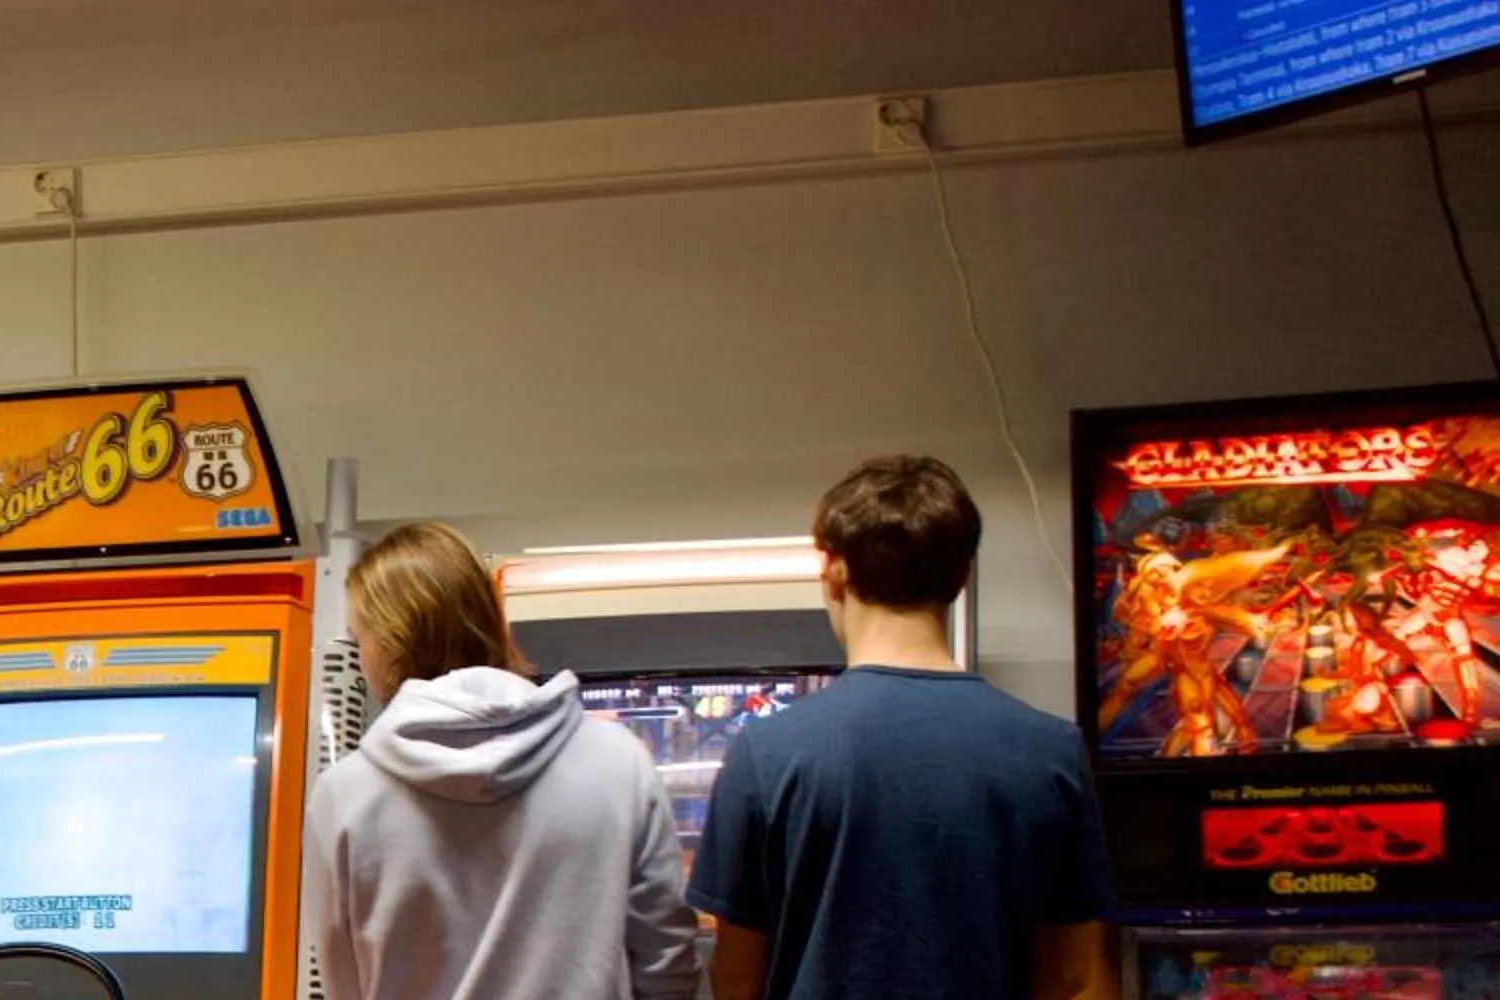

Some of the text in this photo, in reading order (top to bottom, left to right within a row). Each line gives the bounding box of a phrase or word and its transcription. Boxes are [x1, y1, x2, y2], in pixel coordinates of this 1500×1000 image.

[80, 389, 180, 506] 66
[194, 432, 236, 446] ROUTE
[1126, 427, 1437, 484] GLADIATORS
[196, 462, 238, 490] 66
[215, 506, 272, 530] SEGA
[1268, 871, 1377, 894] Gottlieb
[0, 894, 132, 914] PRESS START BUTTON
